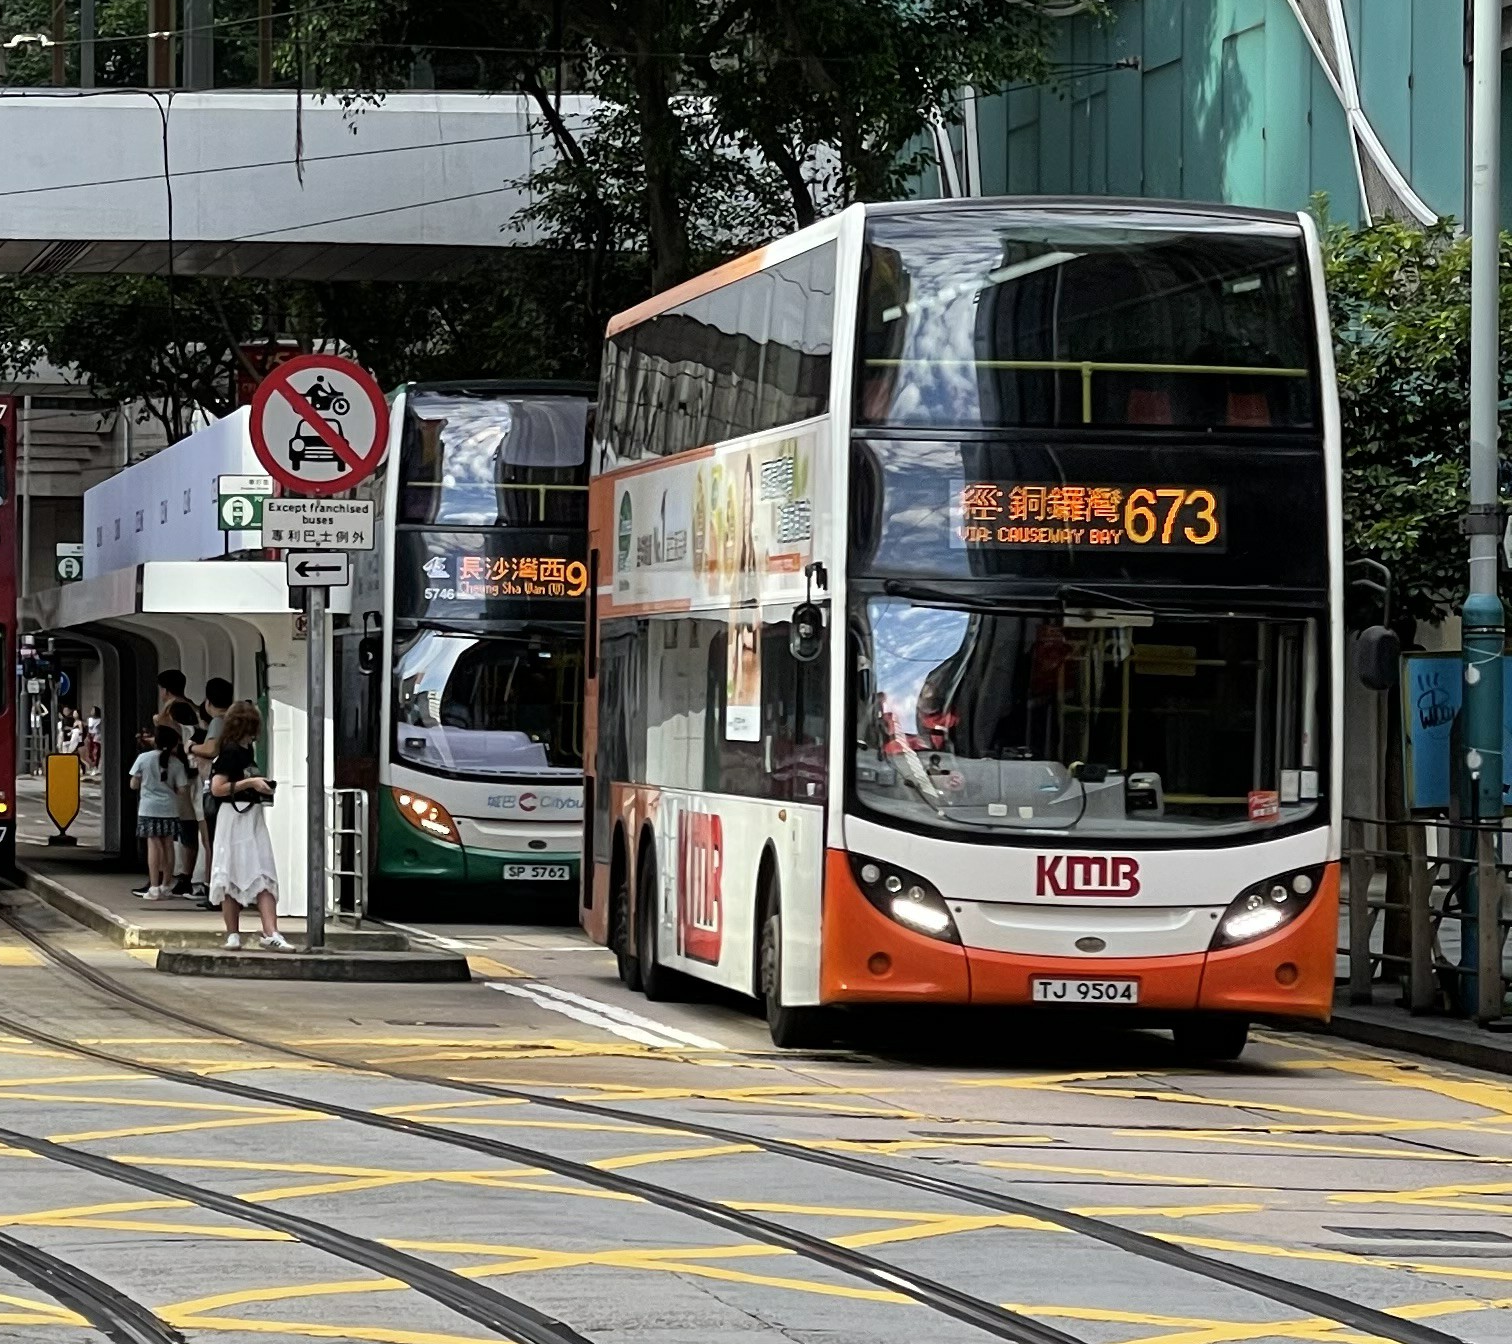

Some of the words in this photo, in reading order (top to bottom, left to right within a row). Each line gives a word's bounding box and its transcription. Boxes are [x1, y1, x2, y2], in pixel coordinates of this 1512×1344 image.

[268, 502, 306, 514] Except
[310, 502, 369, 514] franchised
[302, 515, 334, 525] buses
[1124, 488, 1219, 545] 673
[271, 529, 365, 544] 專利巴士例外
[997, 527, 1086, 544] CAUSEWAY
[1089, 528, 1125, 545] BAY
[424, 587, 455, 600] 5746
[540, 795, 584, 810] Citybu
[509, 866, 526, 878] SP
[531, 866, 566, 878] 5762
[1035, 855, 1140, 898] KMB
[1039, 981, 1067, 1000] TJ
[1076, 982, 1133, 1001] 9504
